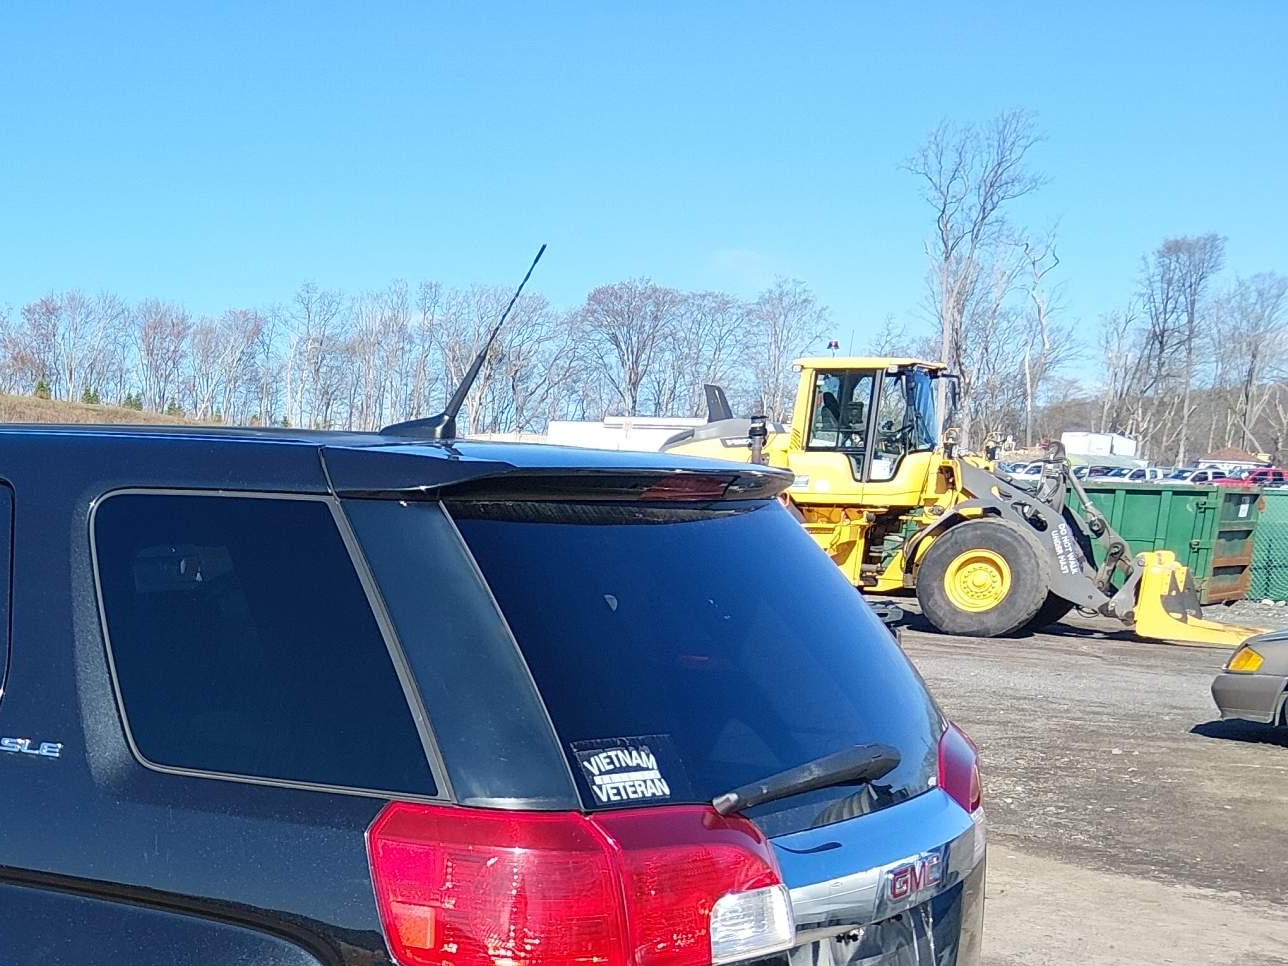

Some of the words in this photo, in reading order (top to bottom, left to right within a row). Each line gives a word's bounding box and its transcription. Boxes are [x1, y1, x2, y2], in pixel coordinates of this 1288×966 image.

[1058, 523, 1068, 536] DO
[1051, 530, 1064, 555] UNDER
[1061, 535, 1073, 553] NOT
[1066, 552, 1079, 575] WALK
[0, 737, 64, 757] SLE
[583, 749, 658, 775] VIETNAM
[592, 778, 671, 802] VETERAN
[888, 853, 941, 900] GMC
